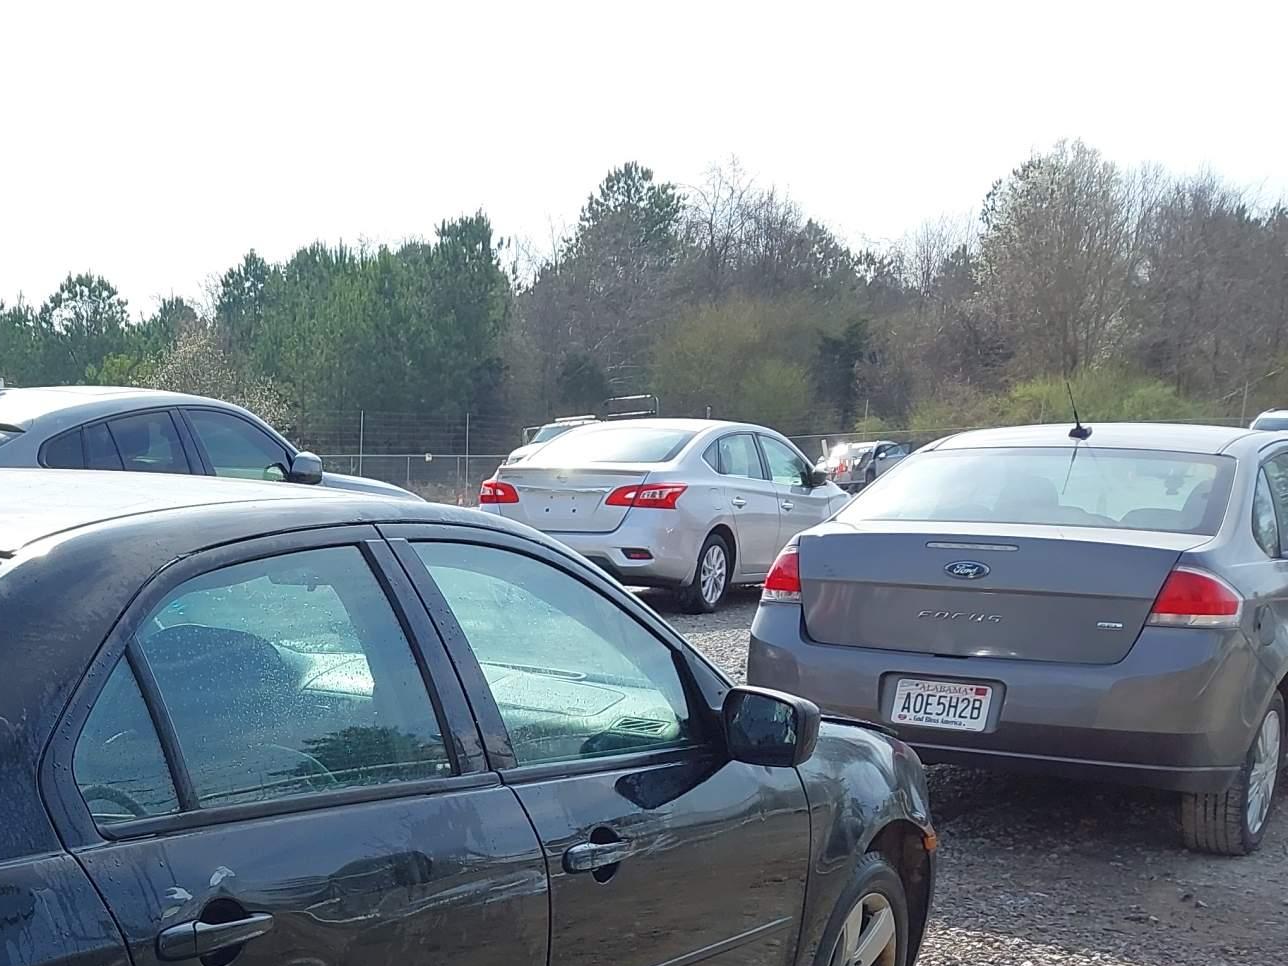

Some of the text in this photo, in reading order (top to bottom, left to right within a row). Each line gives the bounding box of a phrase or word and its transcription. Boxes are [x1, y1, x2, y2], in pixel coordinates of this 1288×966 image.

[954, 563, 978, 577] Ford
[917, 609, 1003, 623] FOCUS
[919, 682, 968, 695] ALABAMA
